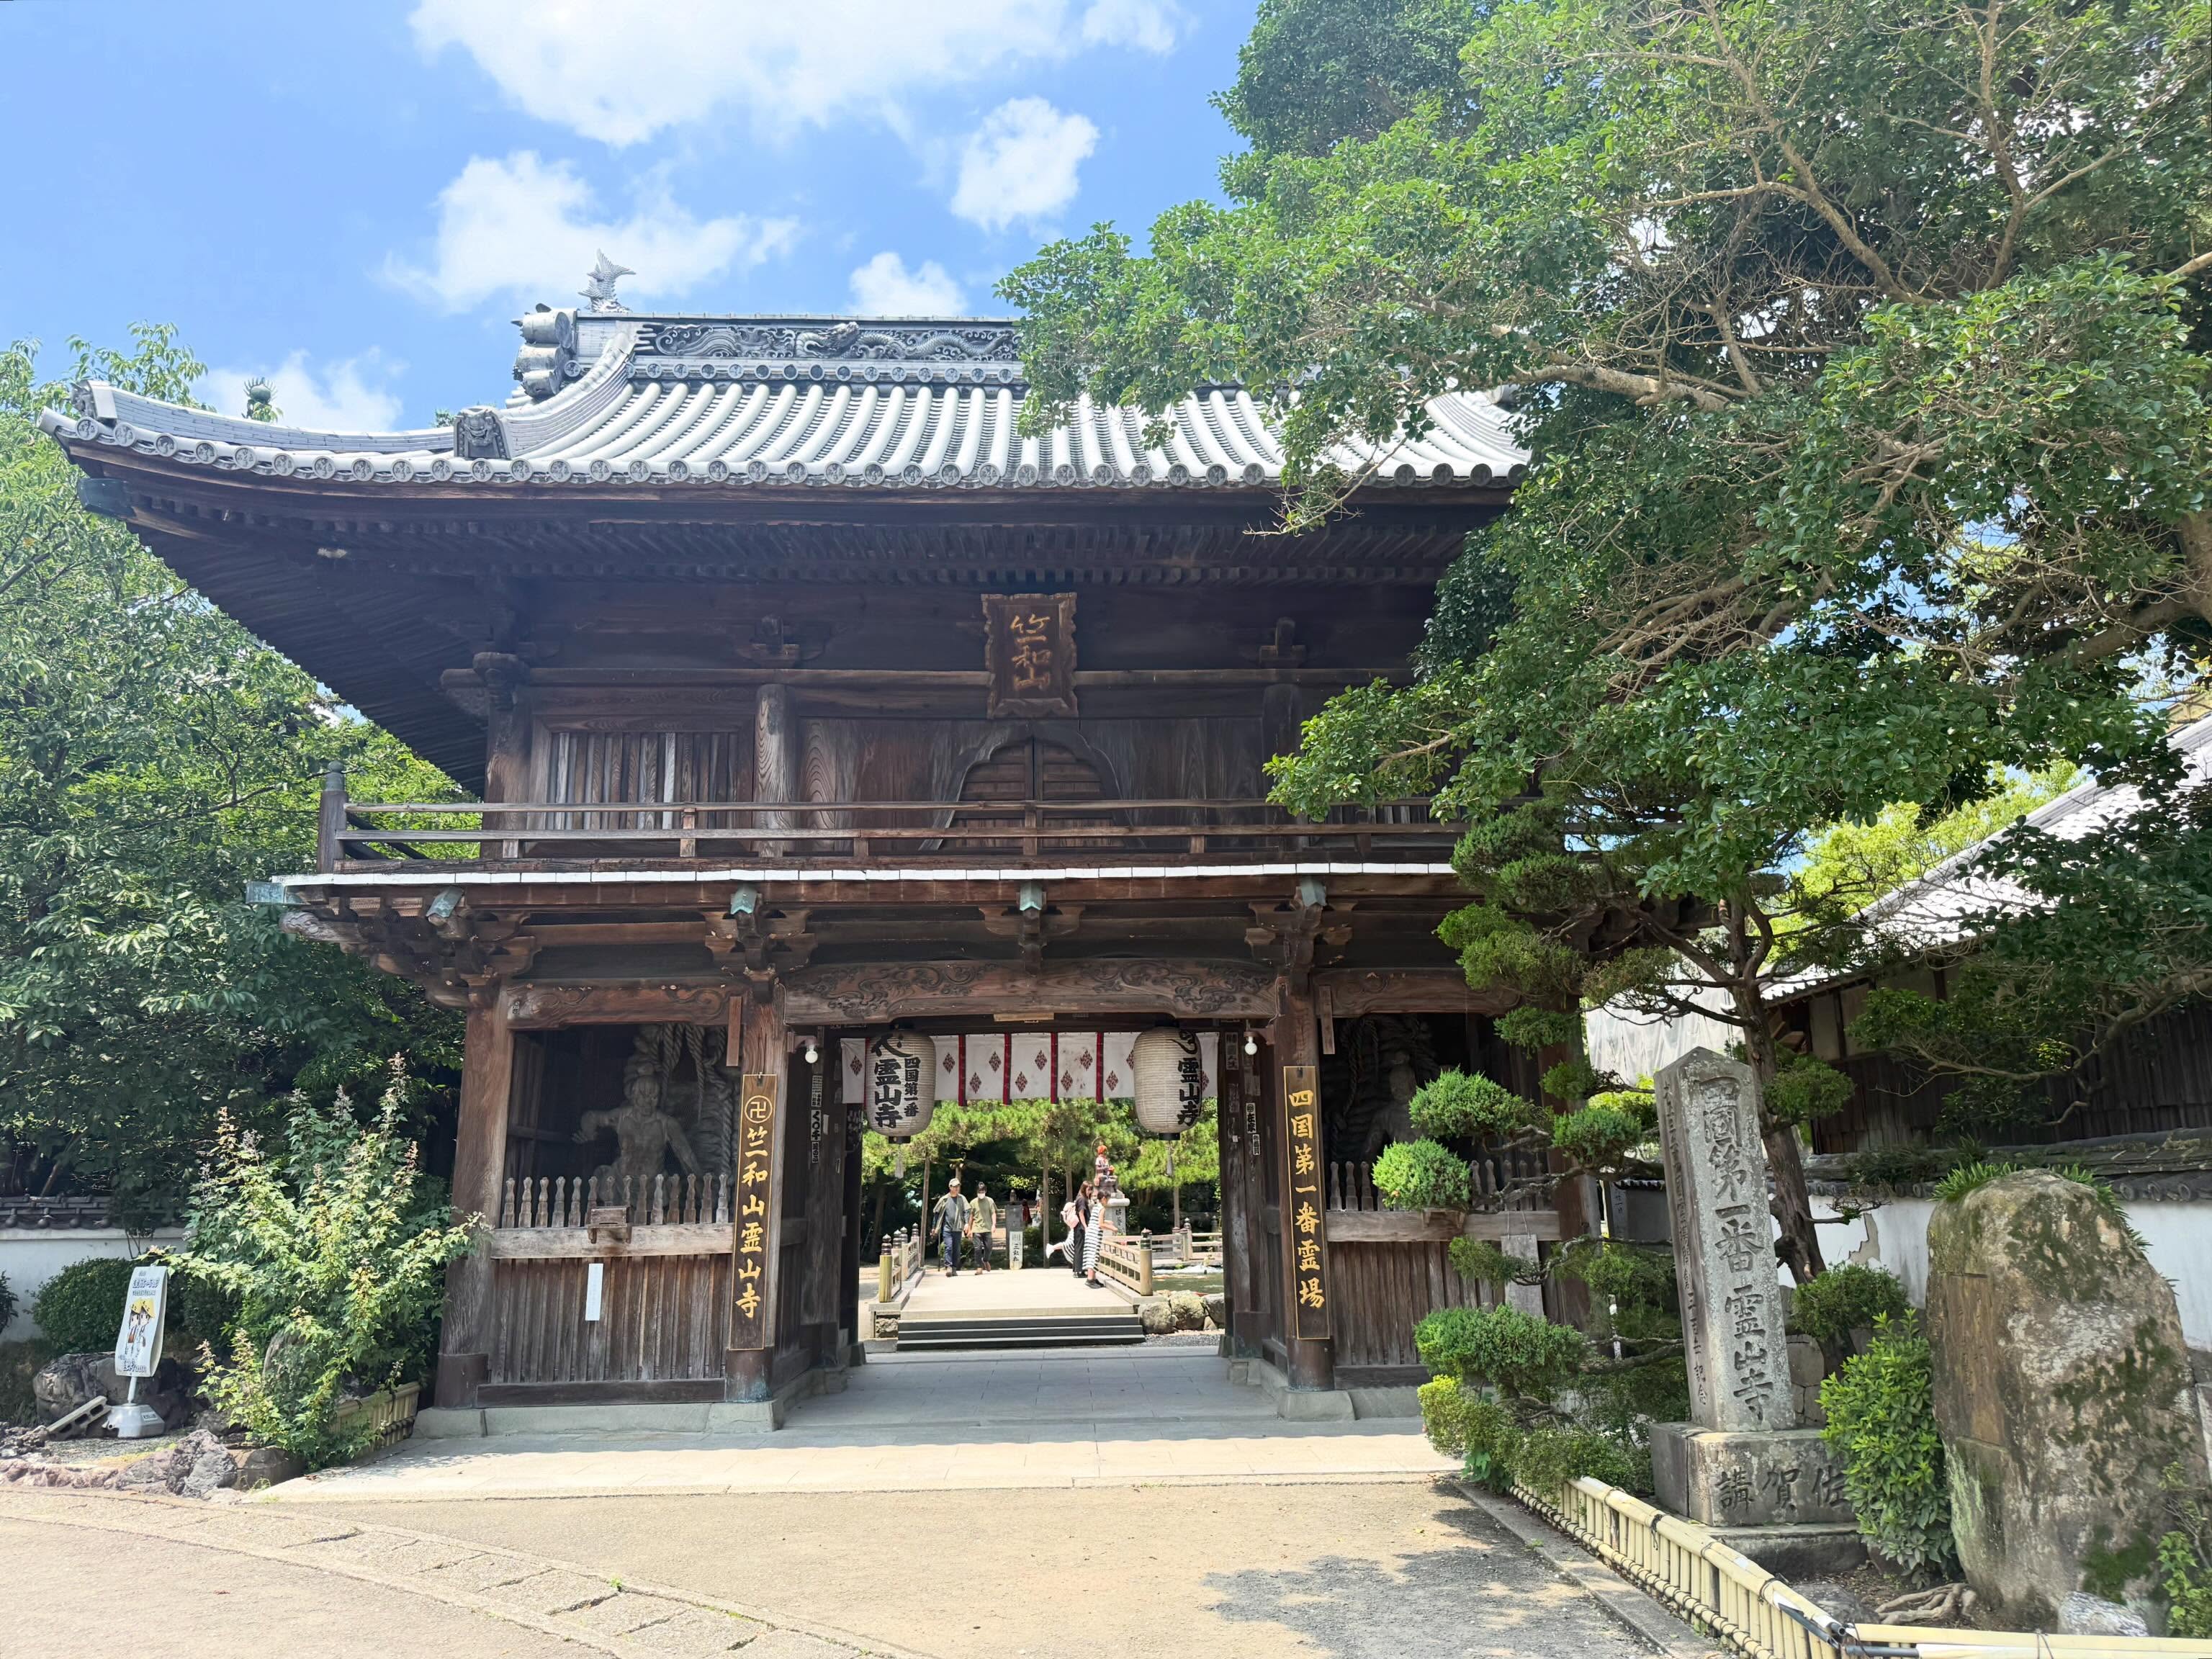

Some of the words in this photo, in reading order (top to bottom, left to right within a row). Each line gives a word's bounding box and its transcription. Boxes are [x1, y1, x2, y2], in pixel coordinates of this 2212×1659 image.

[1010, 613, 1052, 692] 竺和山
[874, 1058, 904, 1128] 霊山寺
[904, 1056, 921, 1117] 四国第一番
[1288, 1089, 1324, 1309] 四国第一番霊場
